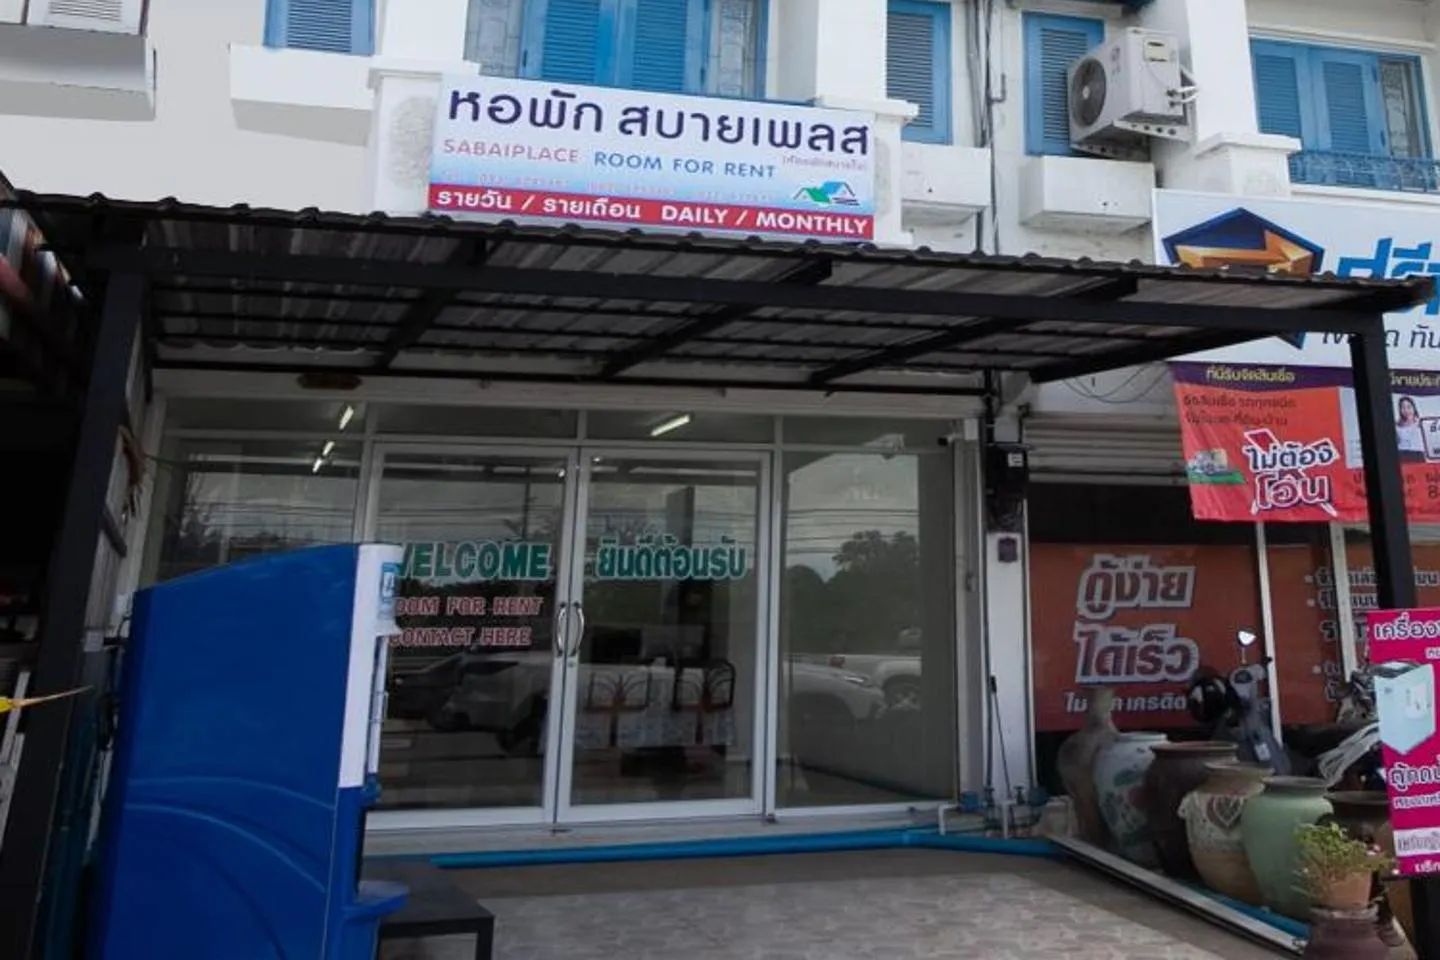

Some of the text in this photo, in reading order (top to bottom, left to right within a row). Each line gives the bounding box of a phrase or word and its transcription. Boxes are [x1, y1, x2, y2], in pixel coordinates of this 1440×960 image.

[448, 87, 870, 156] หอพัก สบายเพลส
[443, 139, 579, 163] SABAIPLACE
[595, 151, 662, 171] ROOM
[674, 158, 713, 176] FOR
[724, 162, 776, 179] RENT
[437, 186, 512, 210] รายวัน
[544, 197, 641, 220] รายเดือน
[662, 205, 728, 226] DAILY
[756, 212, 867, 235] MONTHLY
[1243, 439, 1335, 470] ไม่ต้อง
[597, 534, 749, 579] ยินดีต้อนรับ
[396, 596, 544, 616] OOM FOR RENT
[1080, 555, 1193, 617] กู้ง่าย
[1075, 625, 1196, 681] ได้เร็ว
